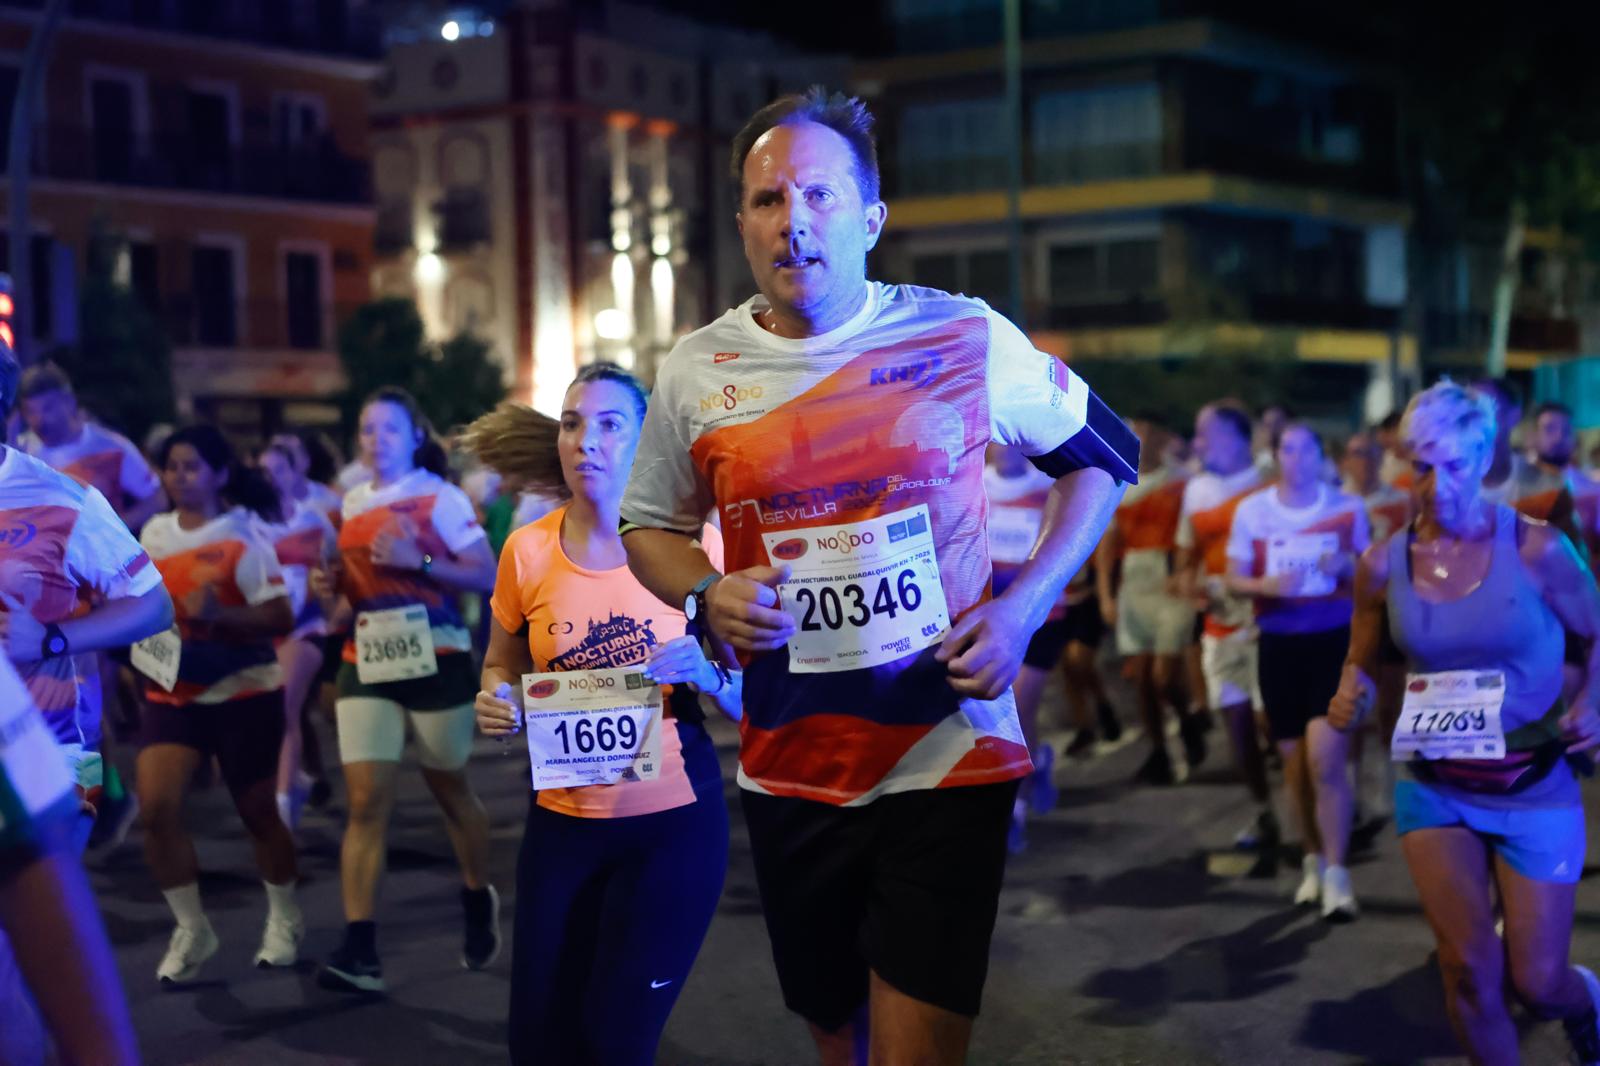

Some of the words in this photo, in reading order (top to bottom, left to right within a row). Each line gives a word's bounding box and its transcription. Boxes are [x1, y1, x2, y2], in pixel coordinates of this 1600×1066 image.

[887, 475, 908, 484] DEL
[758, 477, 888, 510] NOCTURNA
[763, 502, 837, 525] SEVILLA
[800, 575, 834, 584] NOCTURNA
[835, 573, 847, 582] DEL
[848, 562, 899, 580] GUADALQUIVIR
[796, 568, 922, 632] 20346
[363, 632, 423, 664] 23695
[563, 629, 648, 667] NOCTURNA
[880, 636, 911, 652] POWER
[554, 715, 637, 755] 1669
[545, 758, 571, 766] MARIA
[572, 755, 606, 764] ANGELES
[607, 752, 651, 762] DOMINGUEZ
